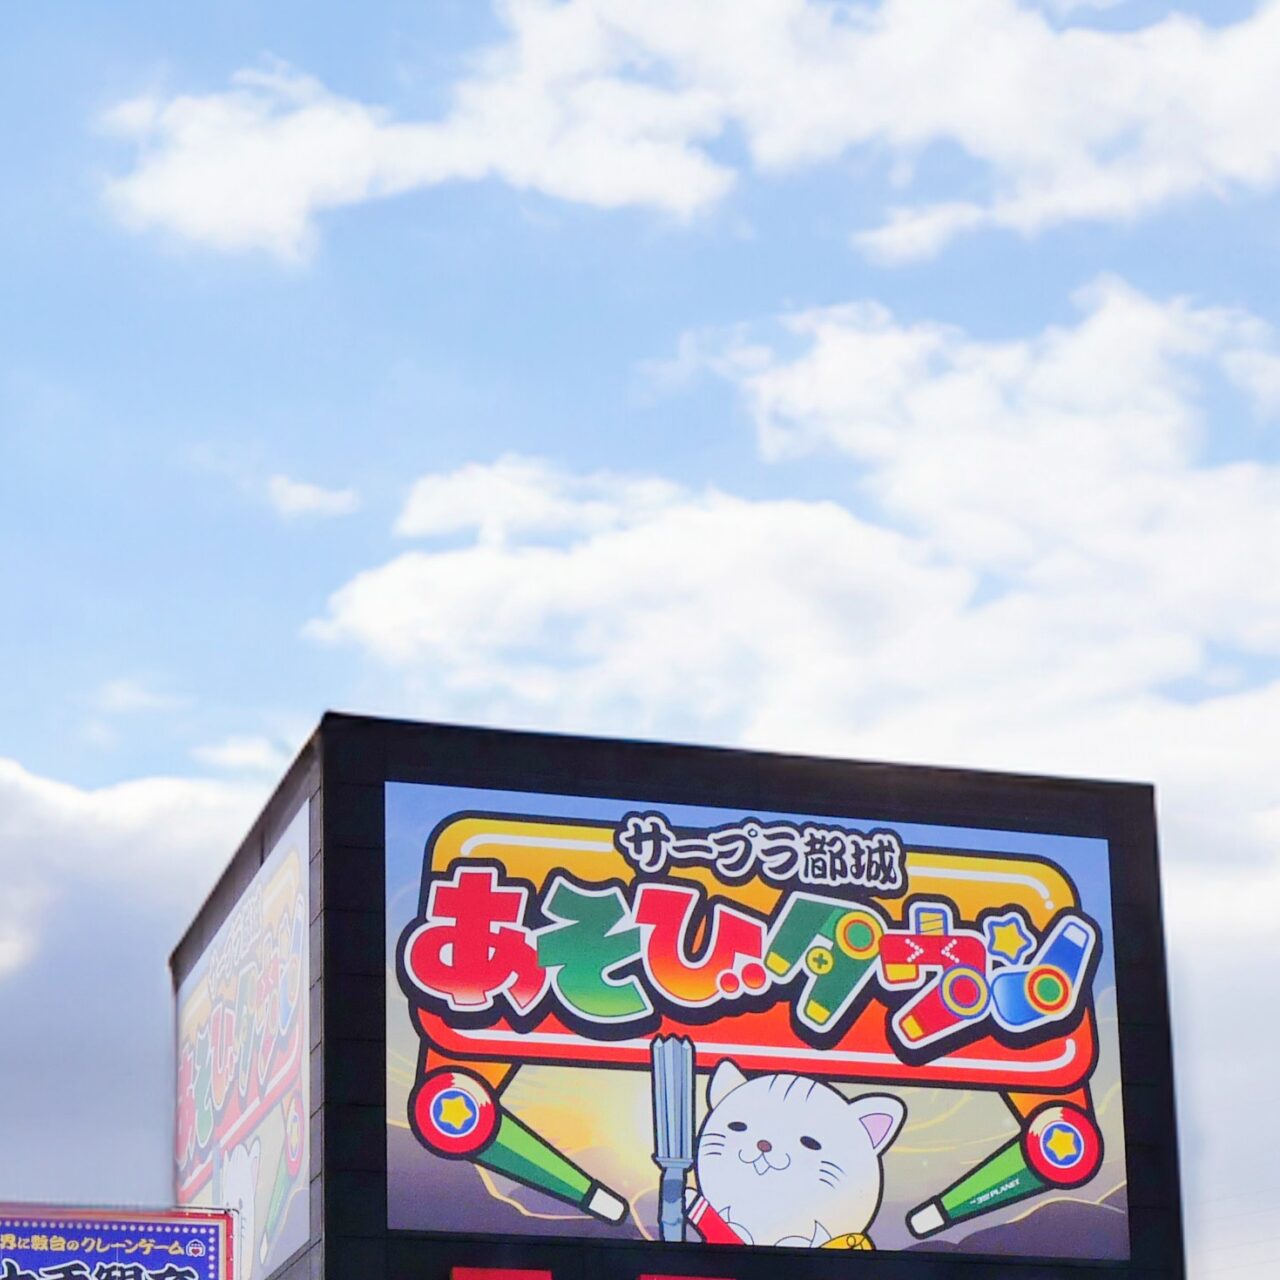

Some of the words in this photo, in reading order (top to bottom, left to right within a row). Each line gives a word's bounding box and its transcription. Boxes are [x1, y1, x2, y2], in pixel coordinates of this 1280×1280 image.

[619, 815, 904, 892] サープラ都城
[410, 862, 1097, 1049] あそびタウン
